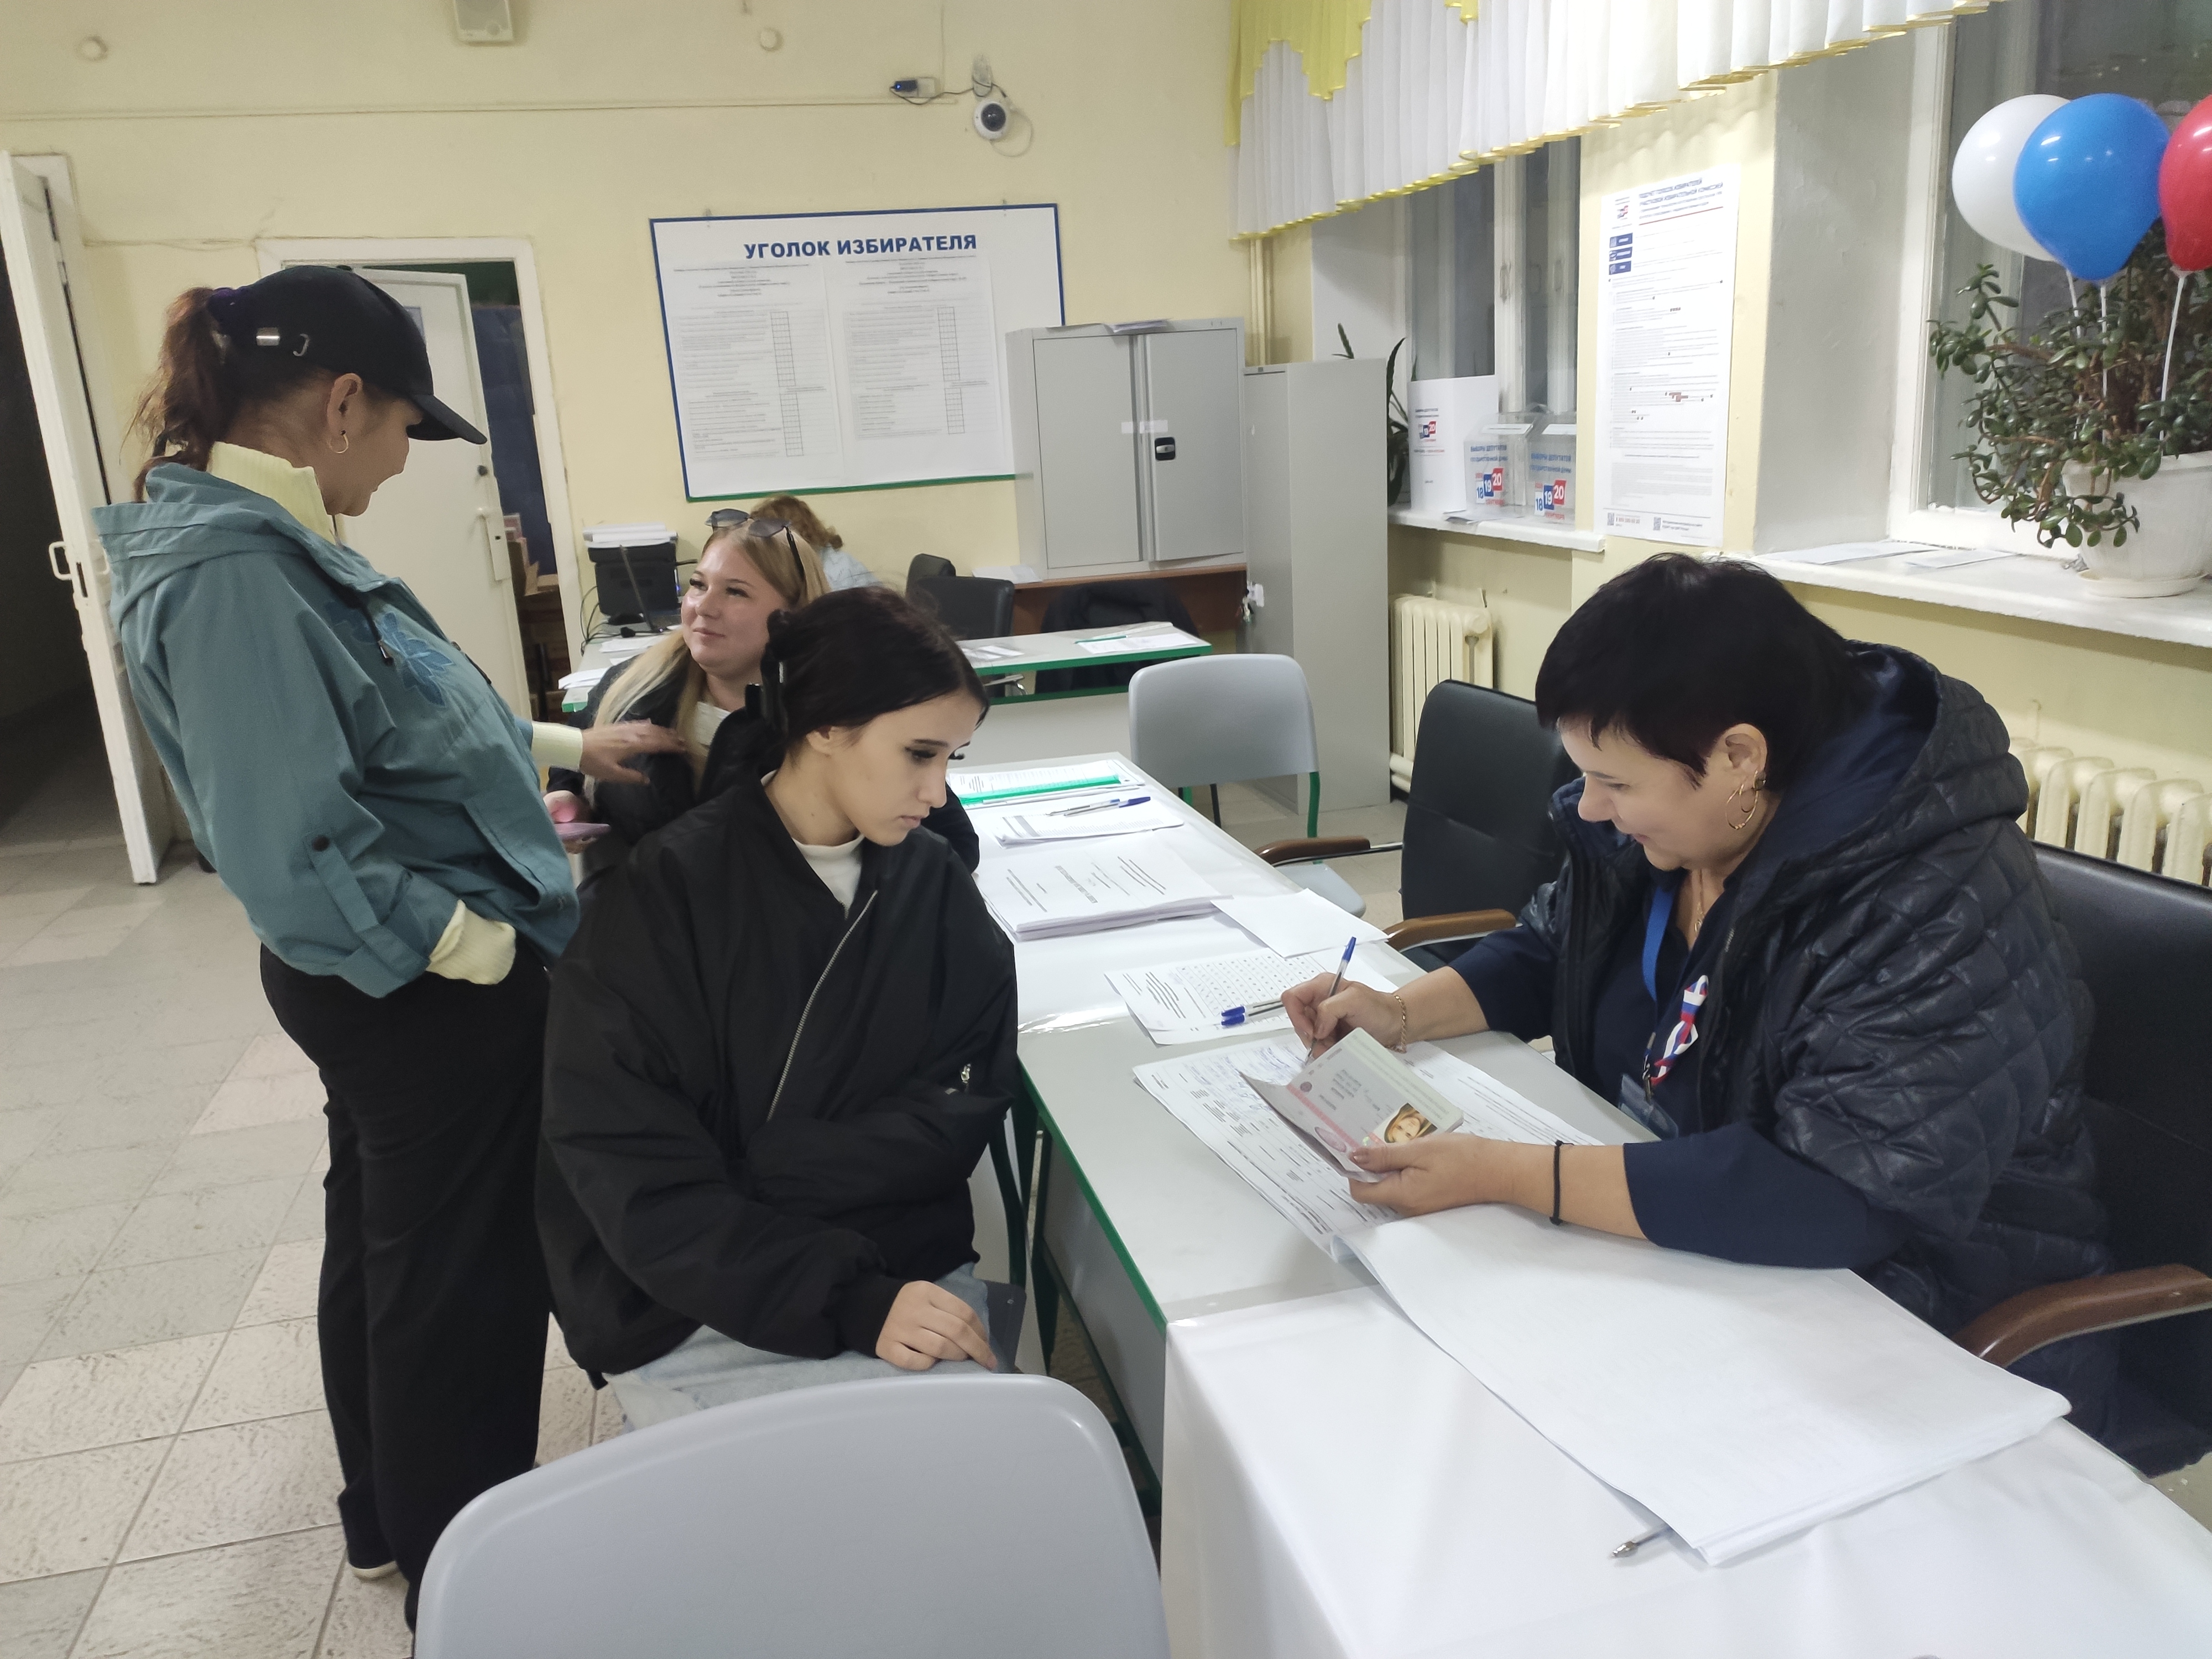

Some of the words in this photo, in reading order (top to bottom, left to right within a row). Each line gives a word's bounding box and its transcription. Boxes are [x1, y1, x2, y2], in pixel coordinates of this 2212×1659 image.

[743, 241, 831, 259] УГОЛОК
[837, 234, 977, 255] ИЗБИРАТЕЛЯ
[1477, 487, 1484, 499] 18
[1484, 479, 1492, 493] 19
[1491, 472, 1502, 486] 20
[1536, 498, 1543, 511] 18
[1544, 490, 1553, 505] 19
[1553, 485, 1564, 499] 20
